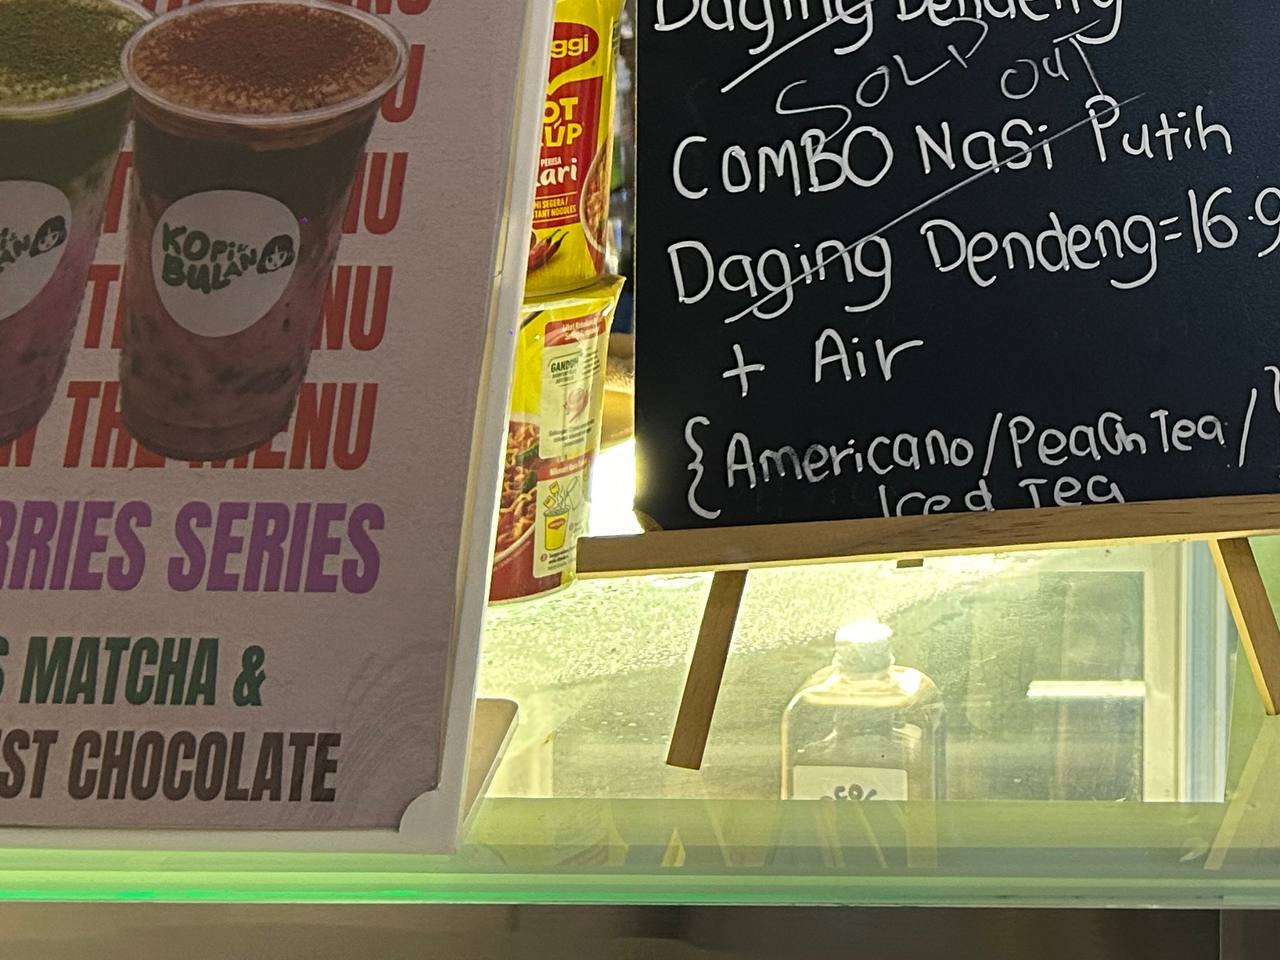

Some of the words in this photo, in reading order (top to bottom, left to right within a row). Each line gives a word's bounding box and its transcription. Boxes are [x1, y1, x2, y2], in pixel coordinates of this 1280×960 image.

[551, 34, 589, 58] ggi
[541, 123, 582, 147] UP
[543, 97, 579, 123] OT
[916, 117, 1053, 173] Nasi
[1087, 96, 1232, 163] Putih
[536, 158, 577, 188] ari
[667, 235, 893, 320] Daging
[815, 328, 924, 383] Air
[167, 501, 385, 594] SERIES
[19, 636, 219, 705] MATCHA
[233, 645, 266, 707] &
[68, 730, 341, 802] CHOCOLATE
